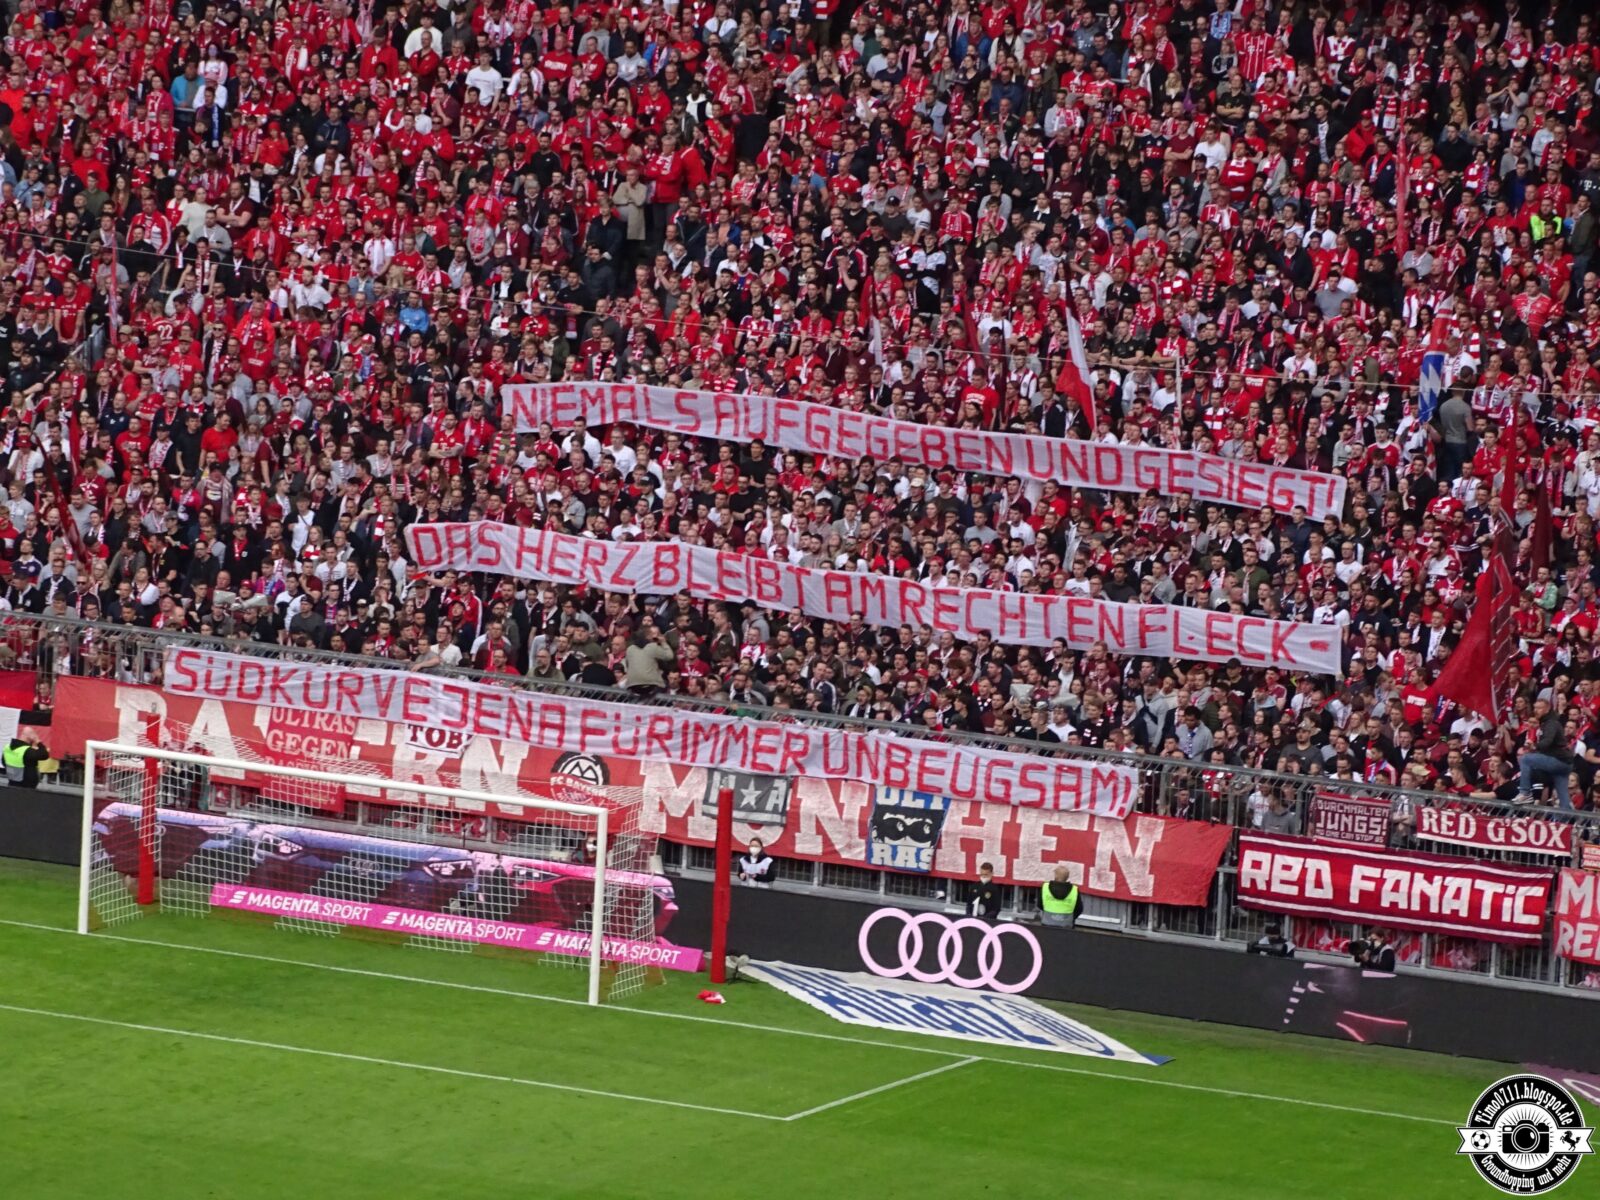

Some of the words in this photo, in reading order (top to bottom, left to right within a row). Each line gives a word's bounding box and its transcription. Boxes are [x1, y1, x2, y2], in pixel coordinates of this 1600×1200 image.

[511, 385, 702, 433] NIEMALS
[713, 393, 1014, 474] AUFGEGEBEN
[1026, 440, 1124, 486] UND
[1133, 450, 1337, 516] GESIEGT!
[412, 523, 503, 568] DAS
[515, 526, 639, 587] HERZ
[652, 544, 811, 608] BLEIBT
[824, 571, 887, 617] AM
[898, 579, 1126, 649] RECHTEN
[1138, 606, 1298, 664] FLECK
[171, 650, 431, 722] SÜDKURVE
[441, 683, 567, 752] JENA
[580, 708, 674, 758] FÜR
[680, 716, 810, 774] IMMER
[822, 729, 1133, 817] UNBEUGSAM!
[271, 705, 357, 735] ULTRAS
[266, 729, 353, 760] GEGEN
[637, 757, 1165, 897] MNHEN
[1315, 810, 1389, 837] JUNGS!
[1421, 807, 1477, 839] RED
[1487, 816, 1567, 849] G'SOX
[247, 890, 320, 915] MAGENTA
[322, 901, 372, 922] SPORT
[400, 912, 472, 936] MAGENTA
[475, 923, 526, 942] SPORT
[553, 933, 627, 958] MAGNTA
[630, 944, 681, 965] SPORT
